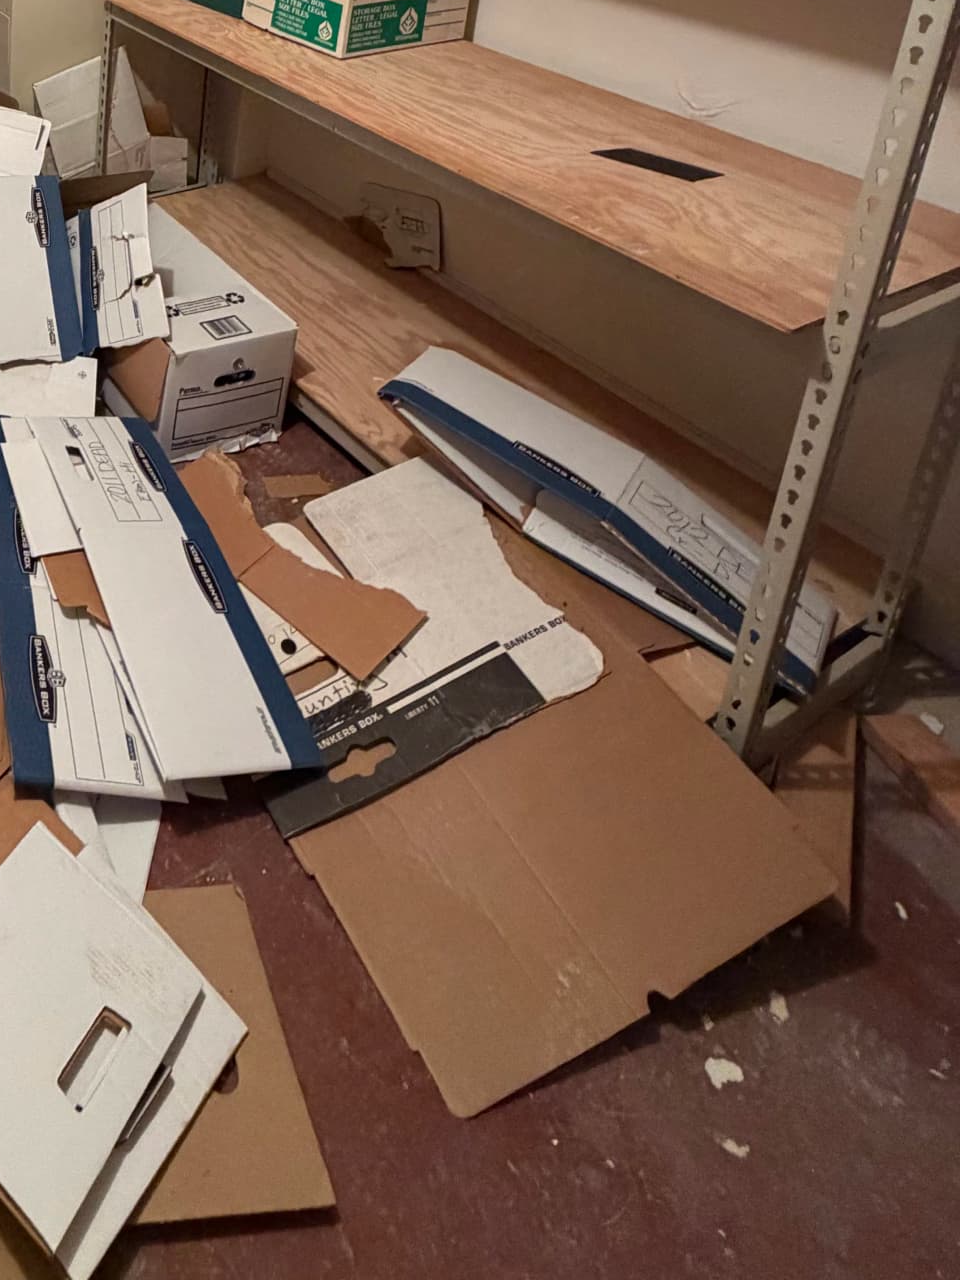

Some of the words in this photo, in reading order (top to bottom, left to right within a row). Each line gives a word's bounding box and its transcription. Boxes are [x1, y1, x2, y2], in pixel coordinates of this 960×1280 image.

[278, 2, 291, 12] SIZE
[291, 7, 310, 19] FILES
[307, 5, 328, 18] LEGAL
[352, 14, 375, 24] LETTER
[353, 6, 382, 15] STORAGE
[365, 21, 382, 29] FILES
[35, 192, 43, 208] BOX
[37, 208, 48, 246] BANKERS
[518, 444, 569, 479] BANKERS
[23, 550, 32, 569] BOX
[189, 544, 202, 564] BOX
[198, 564, 224, 610] BANKERS
[503, 624, 549, 651] BANKERS
[33, 638, 47, 689] BANKERS
[40, 691, 50, 716] BOX
[358, 713, 384, 728] BOX
